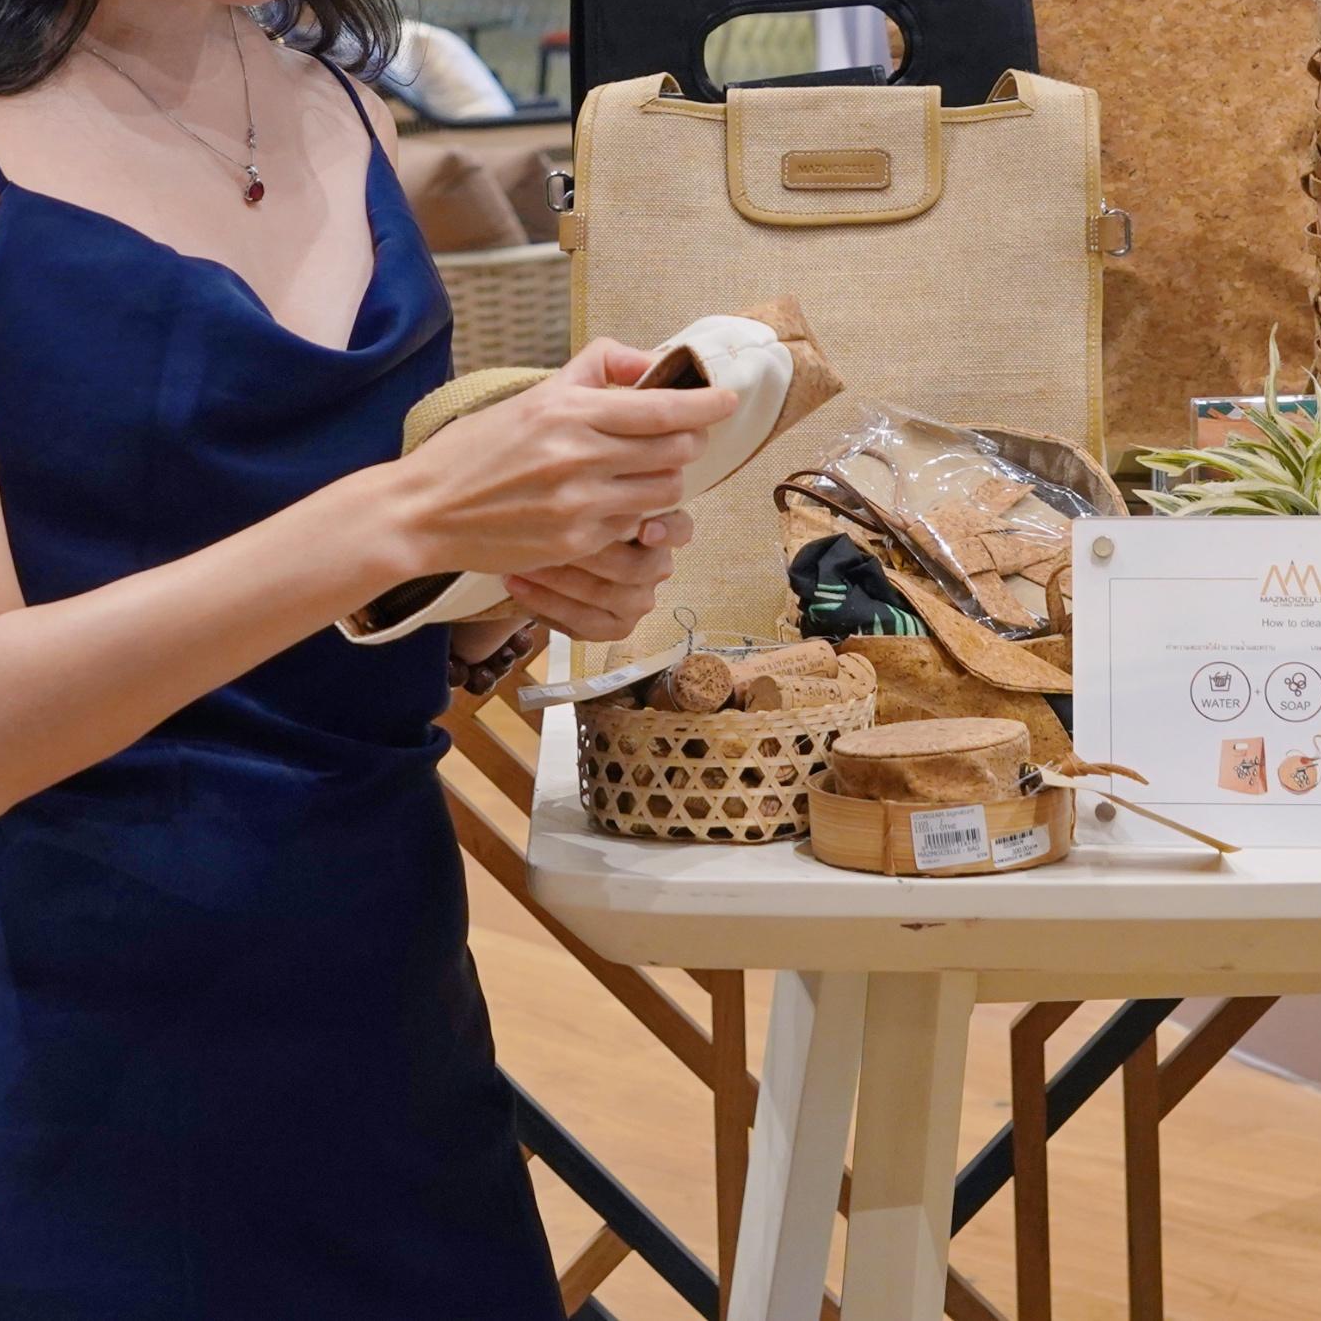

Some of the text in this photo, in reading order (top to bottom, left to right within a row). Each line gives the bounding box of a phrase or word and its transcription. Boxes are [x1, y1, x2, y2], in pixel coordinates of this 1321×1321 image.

[1261, 618, 1284, 628] How
[1287, 618, 1297, 628] to
[1201, 698, 1241, 709] WATER
[1280, 700, 1311, 711] SOAP
